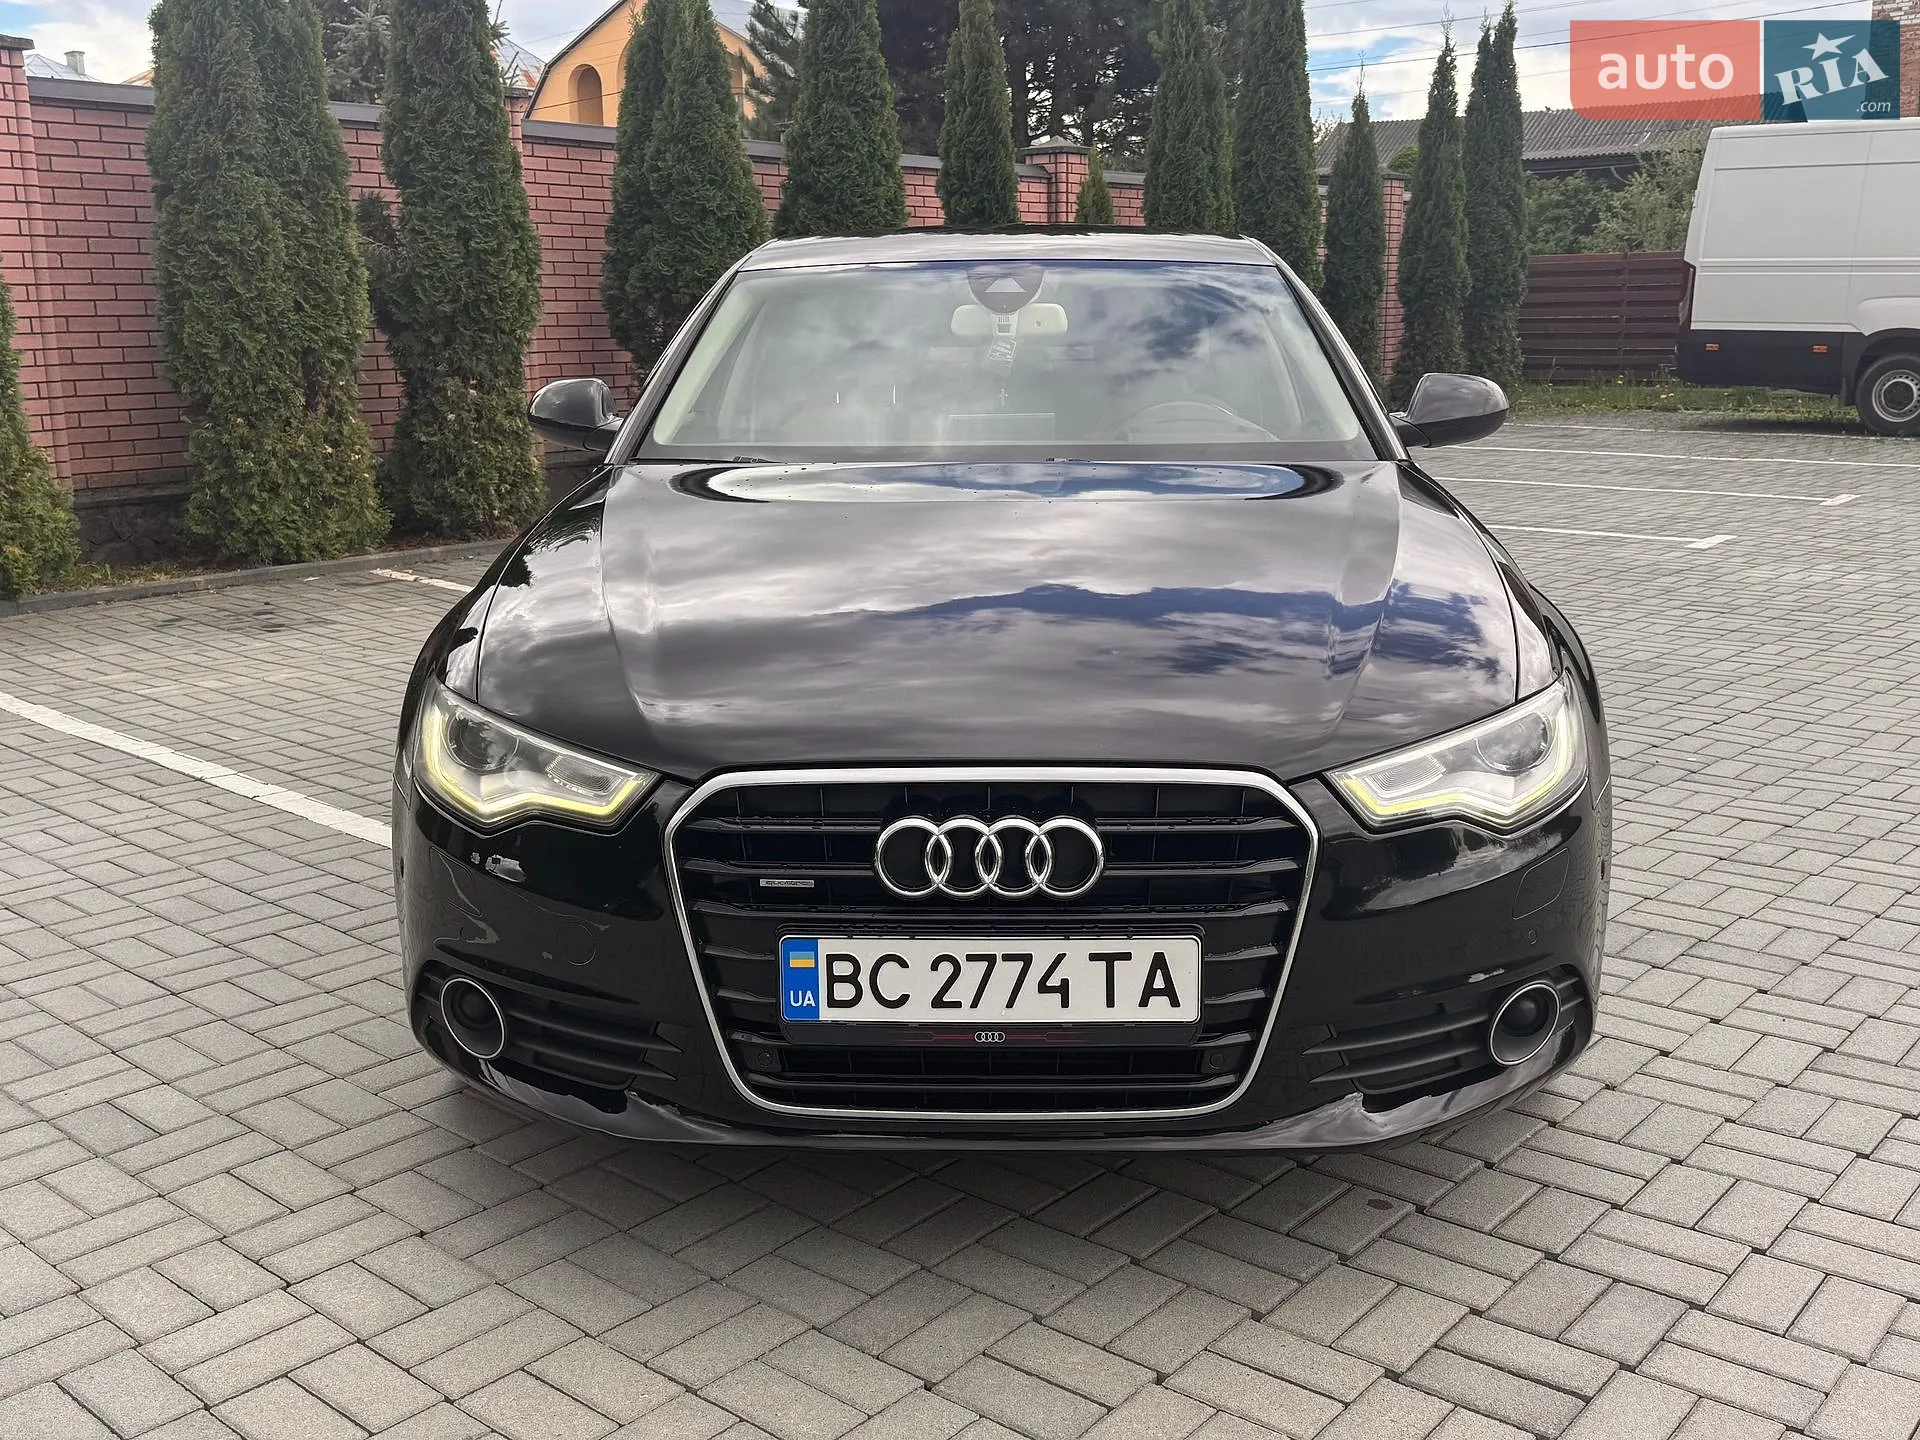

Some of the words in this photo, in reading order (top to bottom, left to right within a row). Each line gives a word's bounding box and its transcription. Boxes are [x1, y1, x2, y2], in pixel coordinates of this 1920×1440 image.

[790, 990, 816, 1007] UA
[825, 952, 911, 1009] BC
[930, 952, 1070, 1009] 2774
[1088, 951, 1181, 1009] TA
